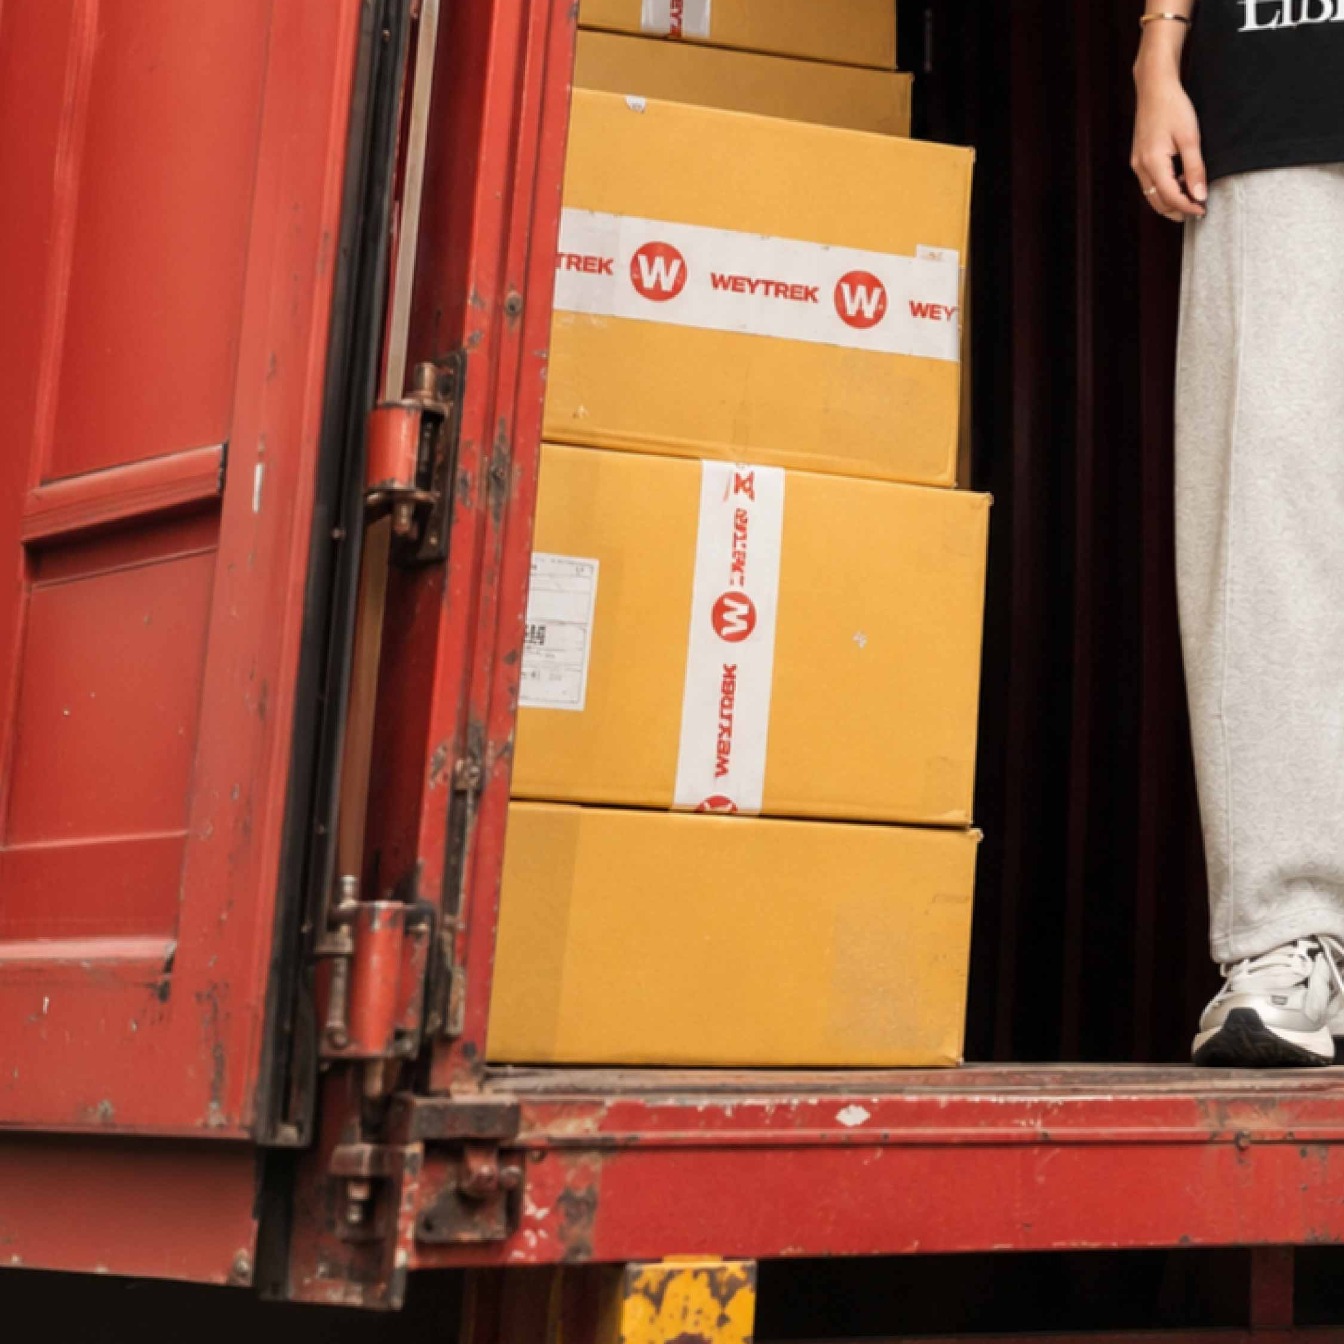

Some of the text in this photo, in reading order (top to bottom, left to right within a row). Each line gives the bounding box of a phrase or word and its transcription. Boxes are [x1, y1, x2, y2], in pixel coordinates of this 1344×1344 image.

[635, 254, 683, 292] W
[710, 271, 820, 304] WEYTREK
[839, 283, 880, 318] W
